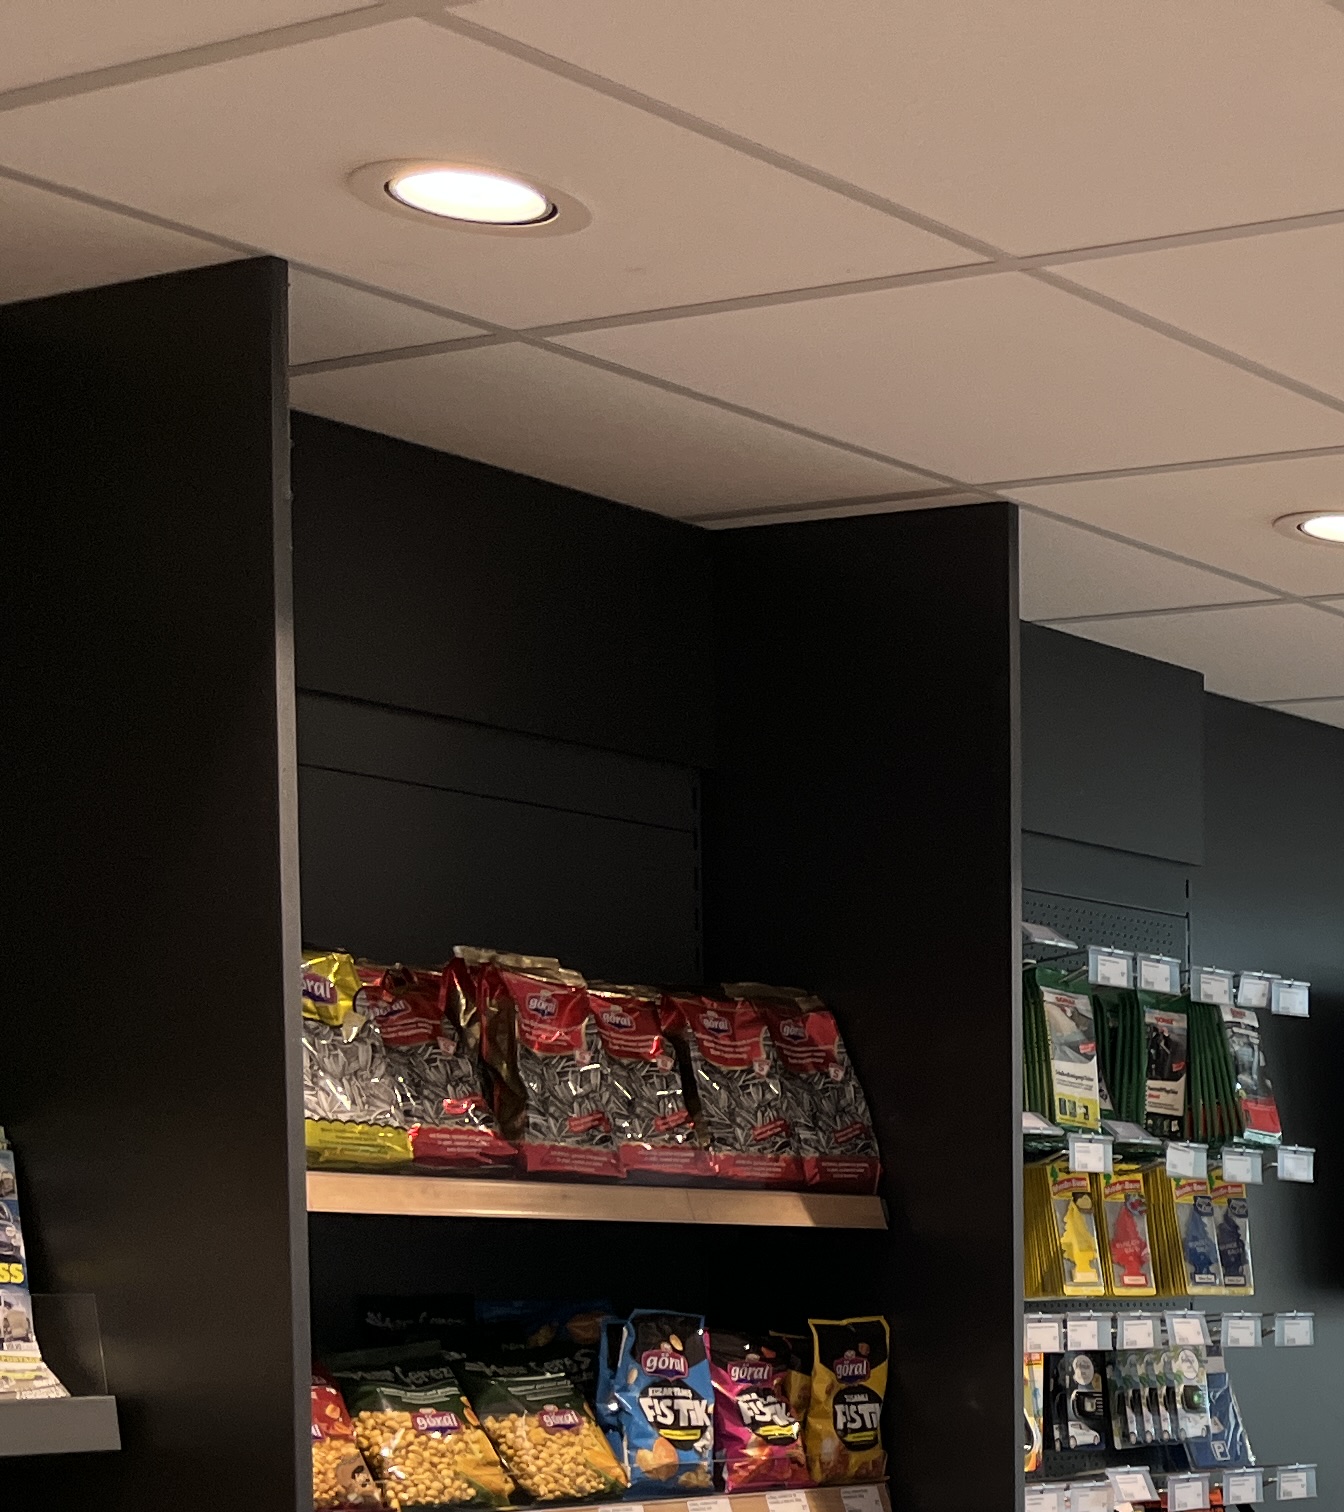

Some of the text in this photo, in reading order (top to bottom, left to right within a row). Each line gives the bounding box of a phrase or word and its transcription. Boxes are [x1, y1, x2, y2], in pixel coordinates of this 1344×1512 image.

[645, 1352, 686, 1374] göral
[731, 1363, 772, 1381] göral
[834, 1359, 869, 1378] göral
[416, 1413, 460, 1431] göral
[834, 1403, 882, 1430] FISTI
